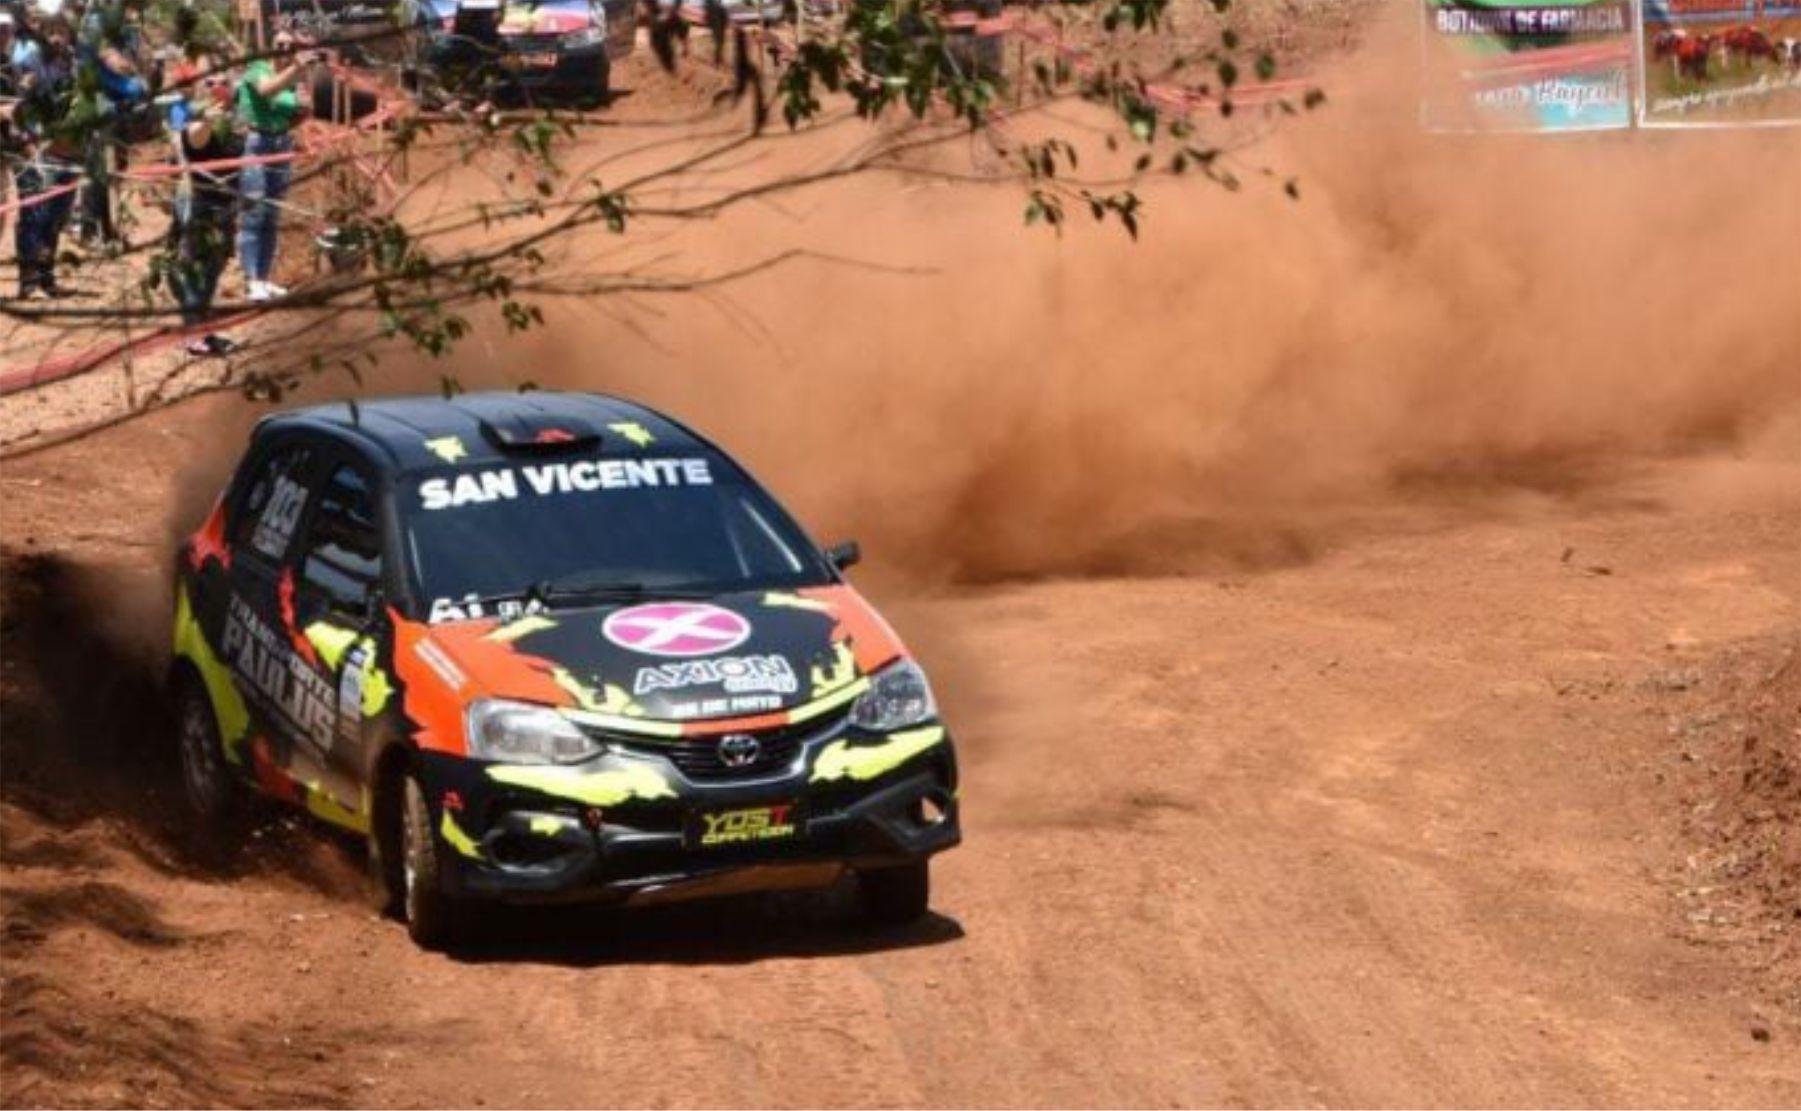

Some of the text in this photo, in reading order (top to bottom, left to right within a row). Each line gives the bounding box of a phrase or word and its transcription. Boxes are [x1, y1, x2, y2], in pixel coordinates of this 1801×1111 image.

[1515, 9, 1538, 32] DE
[419, 457, 714, 509] SAN VICENTE
[634, 655, 798, 695] AXION
[702, 805, 792, 834] YOST
